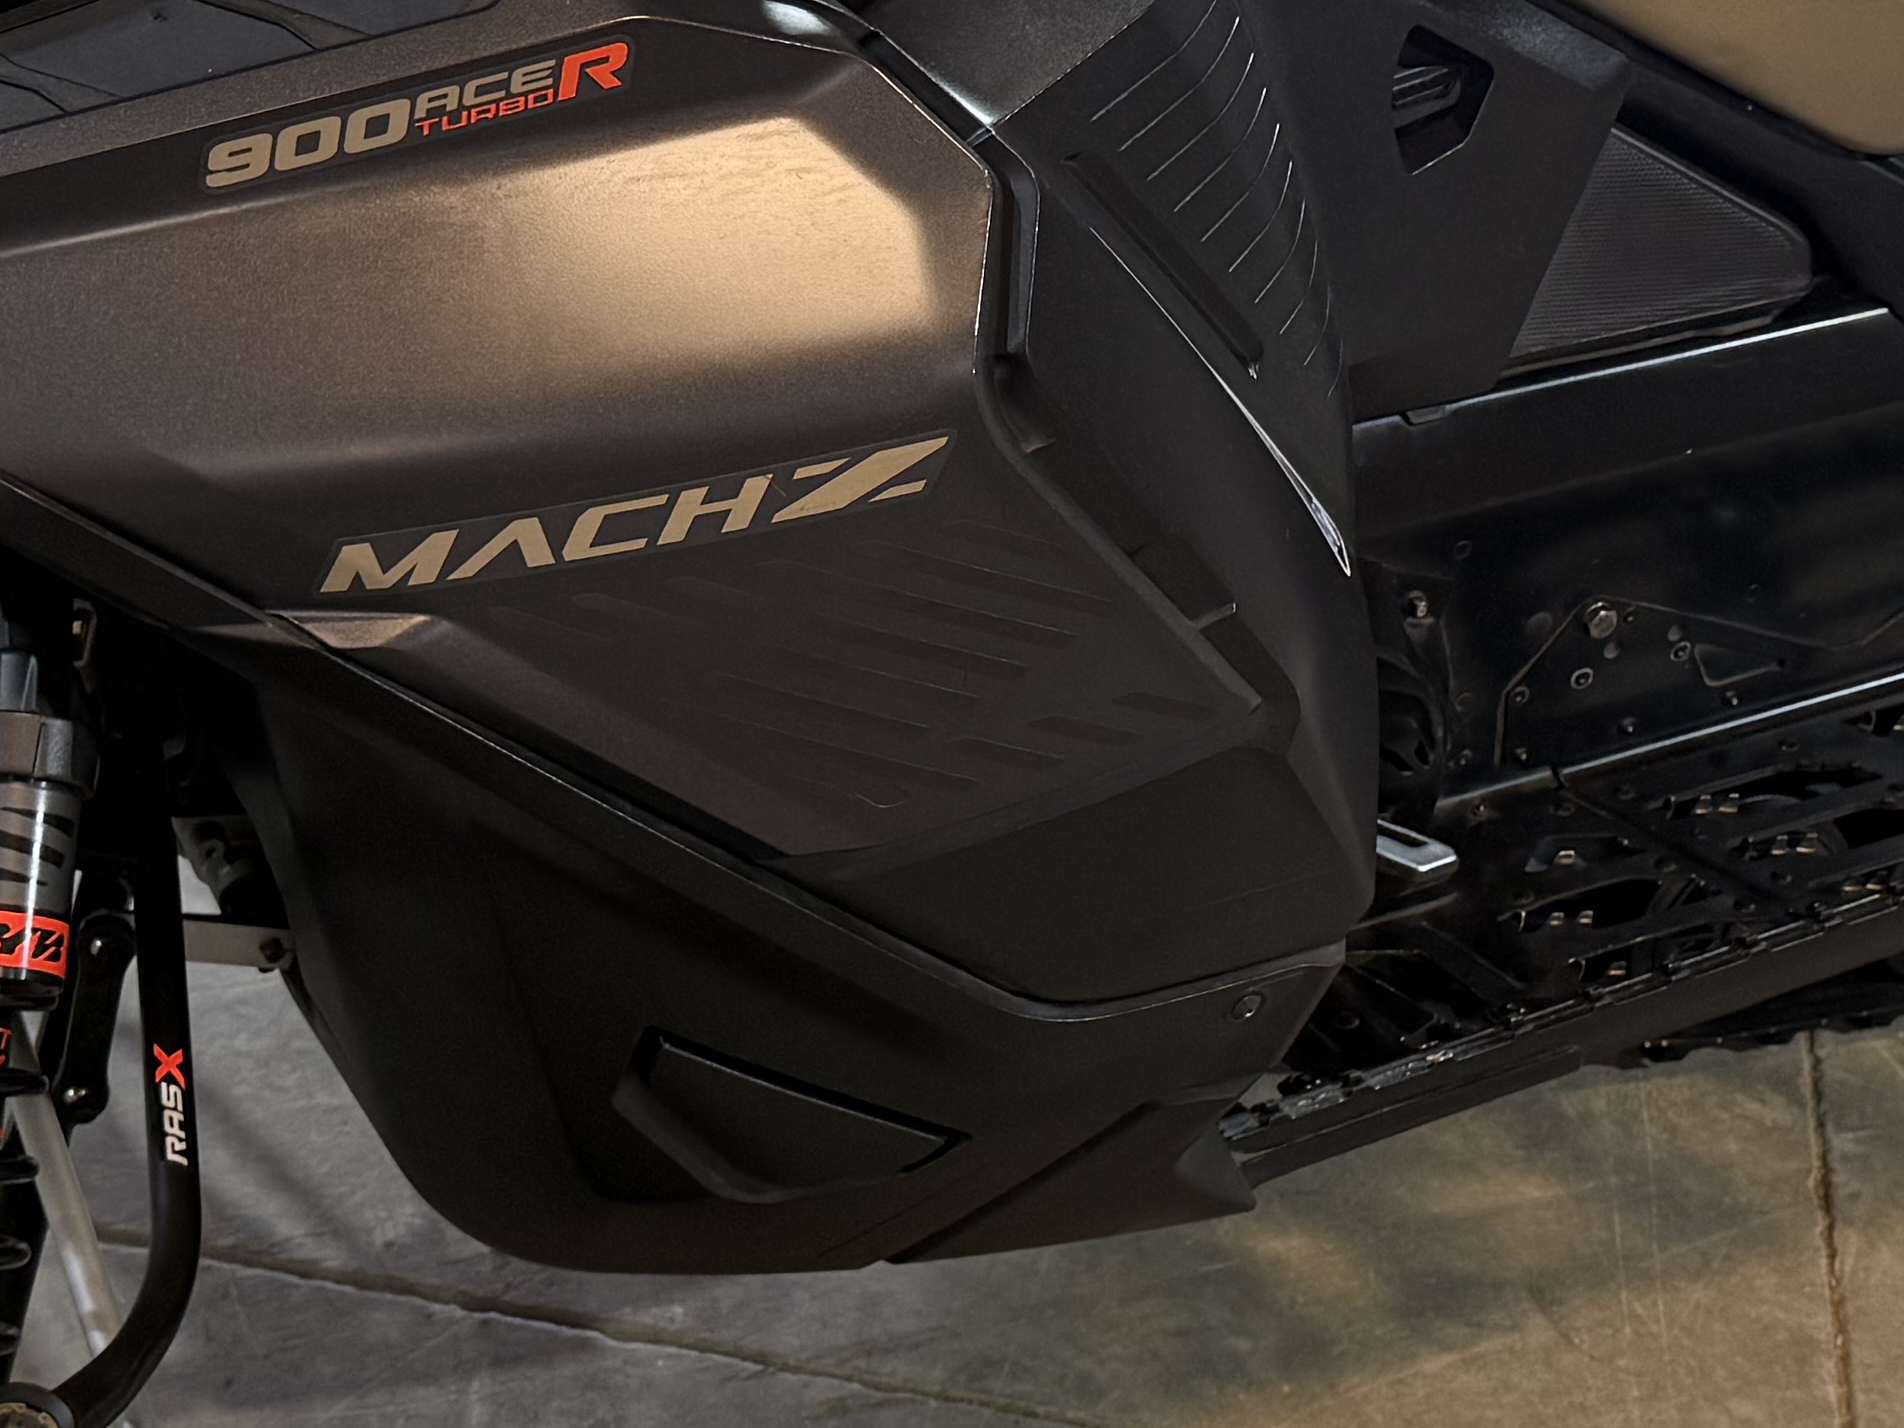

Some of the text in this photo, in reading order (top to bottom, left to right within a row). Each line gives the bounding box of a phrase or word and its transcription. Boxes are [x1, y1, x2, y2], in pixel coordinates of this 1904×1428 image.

[205, 98, 412, 188] 900
[414, 59, 557, 120] ACE
[414, 88, 554, 136] TURBO
